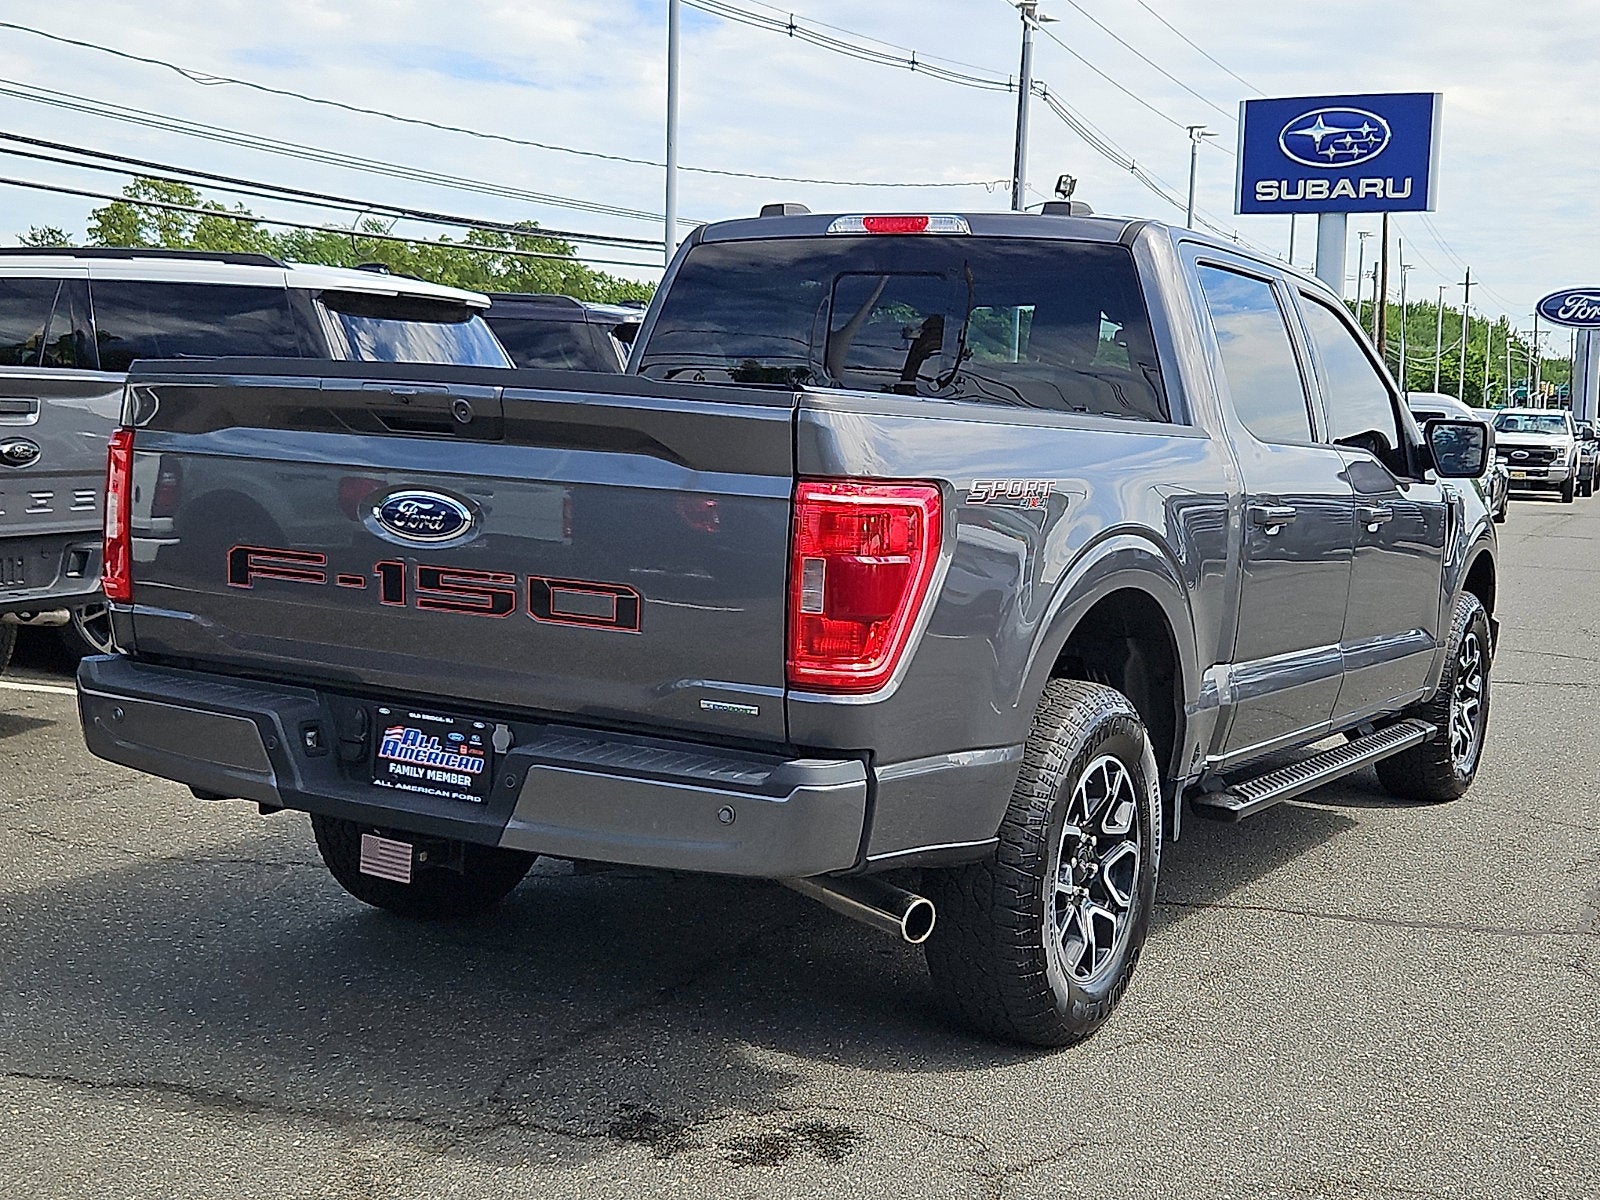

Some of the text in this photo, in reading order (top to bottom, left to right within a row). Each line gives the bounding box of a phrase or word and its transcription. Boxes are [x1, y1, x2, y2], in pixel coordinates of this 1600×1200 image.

[1255, 177, 1413, 201] SUBARU
[1558, 294, 1600, 319] For
[965, 478, 1057, 505] SPORT
[394, 500, 445, 531] Ford
[226, 544, 642, 634] F-150
[388, 763, 472, 787] FAMILY MEMBER
[373, 780, 482, 803] ALL AMERICAN FORD
